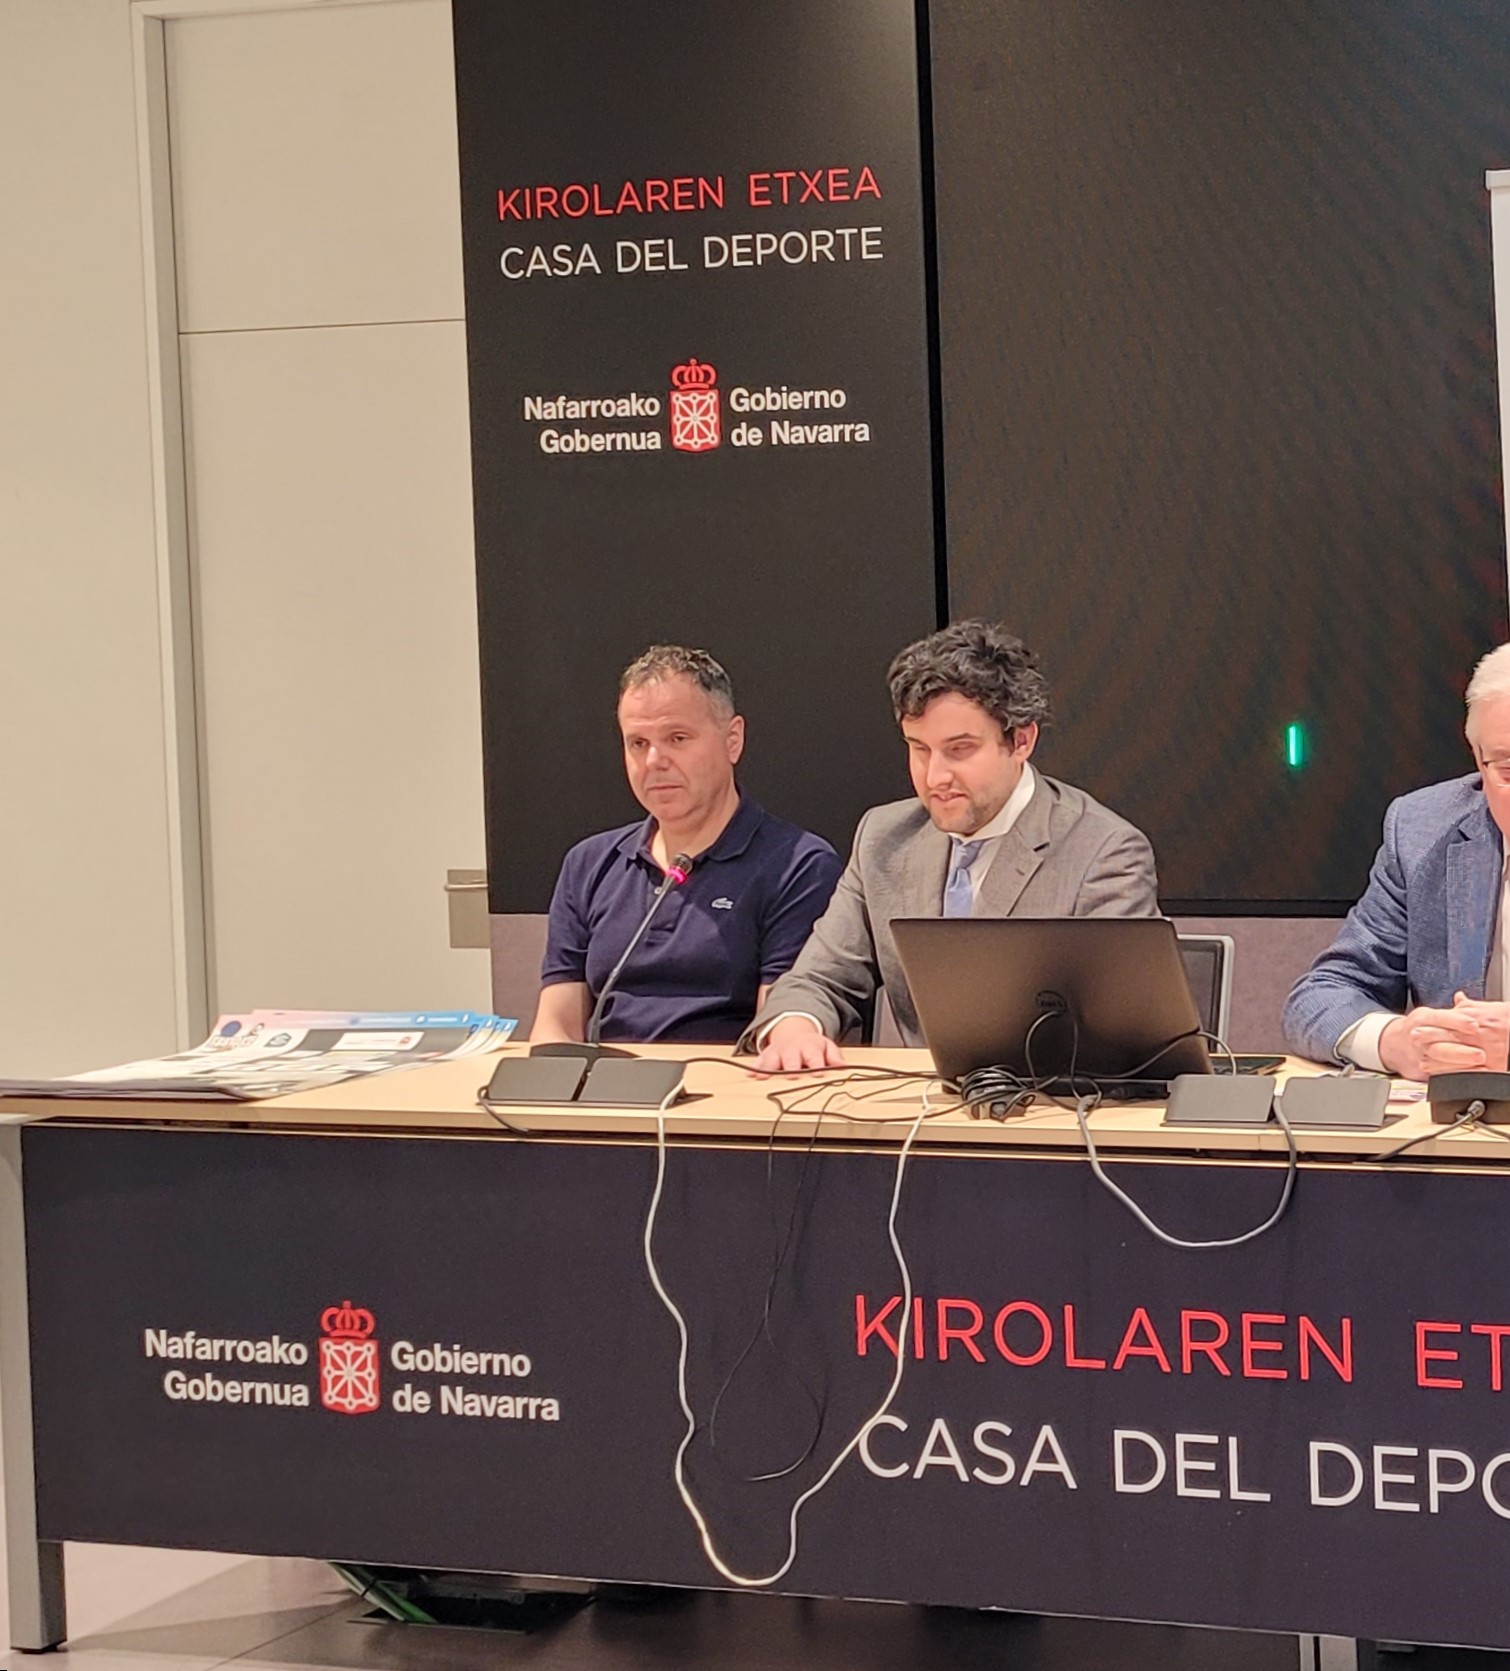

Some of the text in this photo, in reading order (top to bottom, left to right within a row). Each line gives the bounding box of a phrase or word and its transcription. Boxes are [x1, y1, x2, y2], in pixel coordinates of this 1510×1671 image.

[497, 166, 882, 221] KIROLAREN ETXEA
[500, 226, 884, 279] CASA DEL DEPORTE
[524, 392, 661, 421] Nafarroako
[729, 386, 847, 413] Gobierno
[540, 428, 662, 454] Gobernua
[730, 419, 871, 447] de Navarra
[144, 1328, 309, 1366] Nafarroako
[855, 1293, 1354, 1383] KIROLAREN
[390, 1340, 532, 1377] Gobierno
[163, 1369, 310, 1407] Gobernua
[392, 1383, 560, 1421] de Navarra
[858, 1413, 1078, 1490] CASA
[1113, 1429, 1272, 1502] DEL
